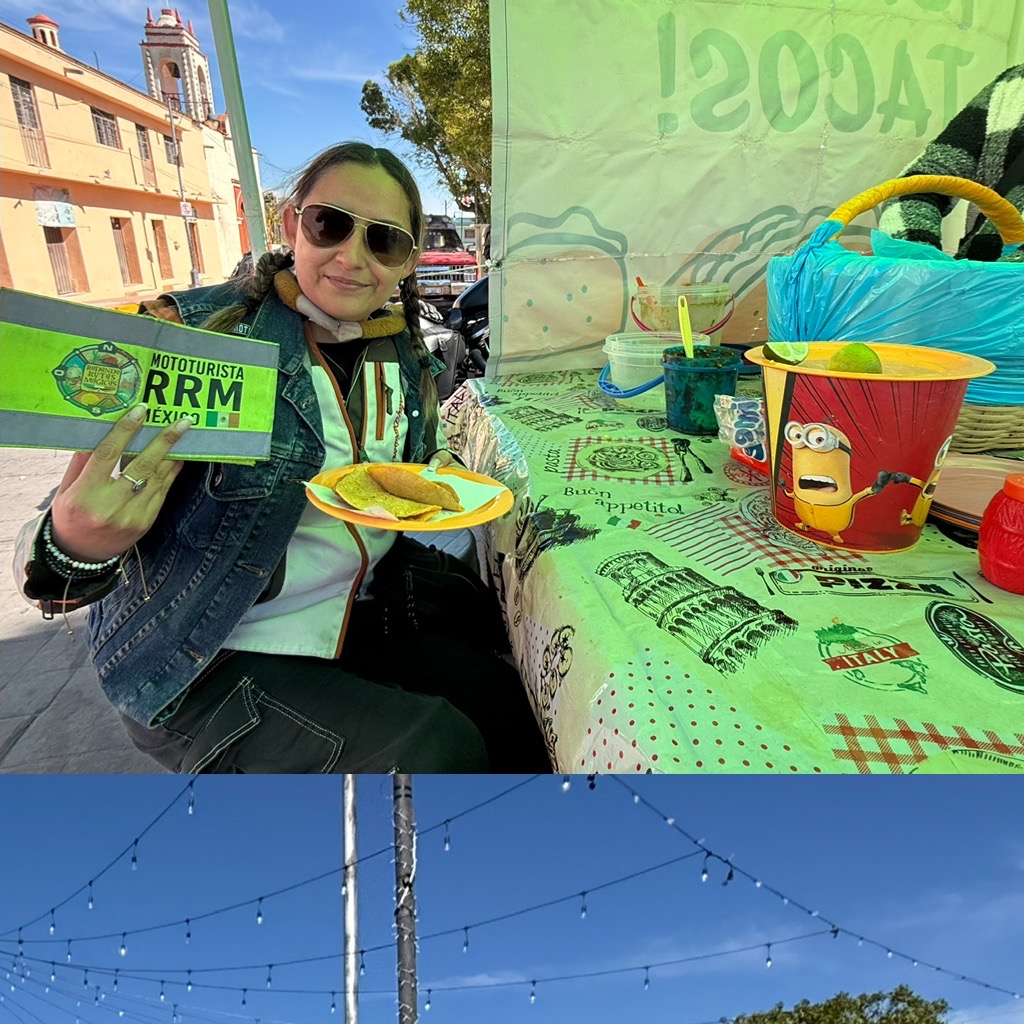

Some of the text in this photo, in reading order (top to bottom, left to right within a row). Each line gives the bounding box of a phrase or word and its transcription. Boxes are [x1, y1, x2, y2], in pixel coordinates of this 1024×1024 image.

[151, 352, 244, 380] MOTOTURISTA
[142, 368, 244, 412] RRM
[594, 498, 685, 514] appetito!
[813, 574, 955, 597] PIZZA
[841, 646, 899, 668] ITALY
